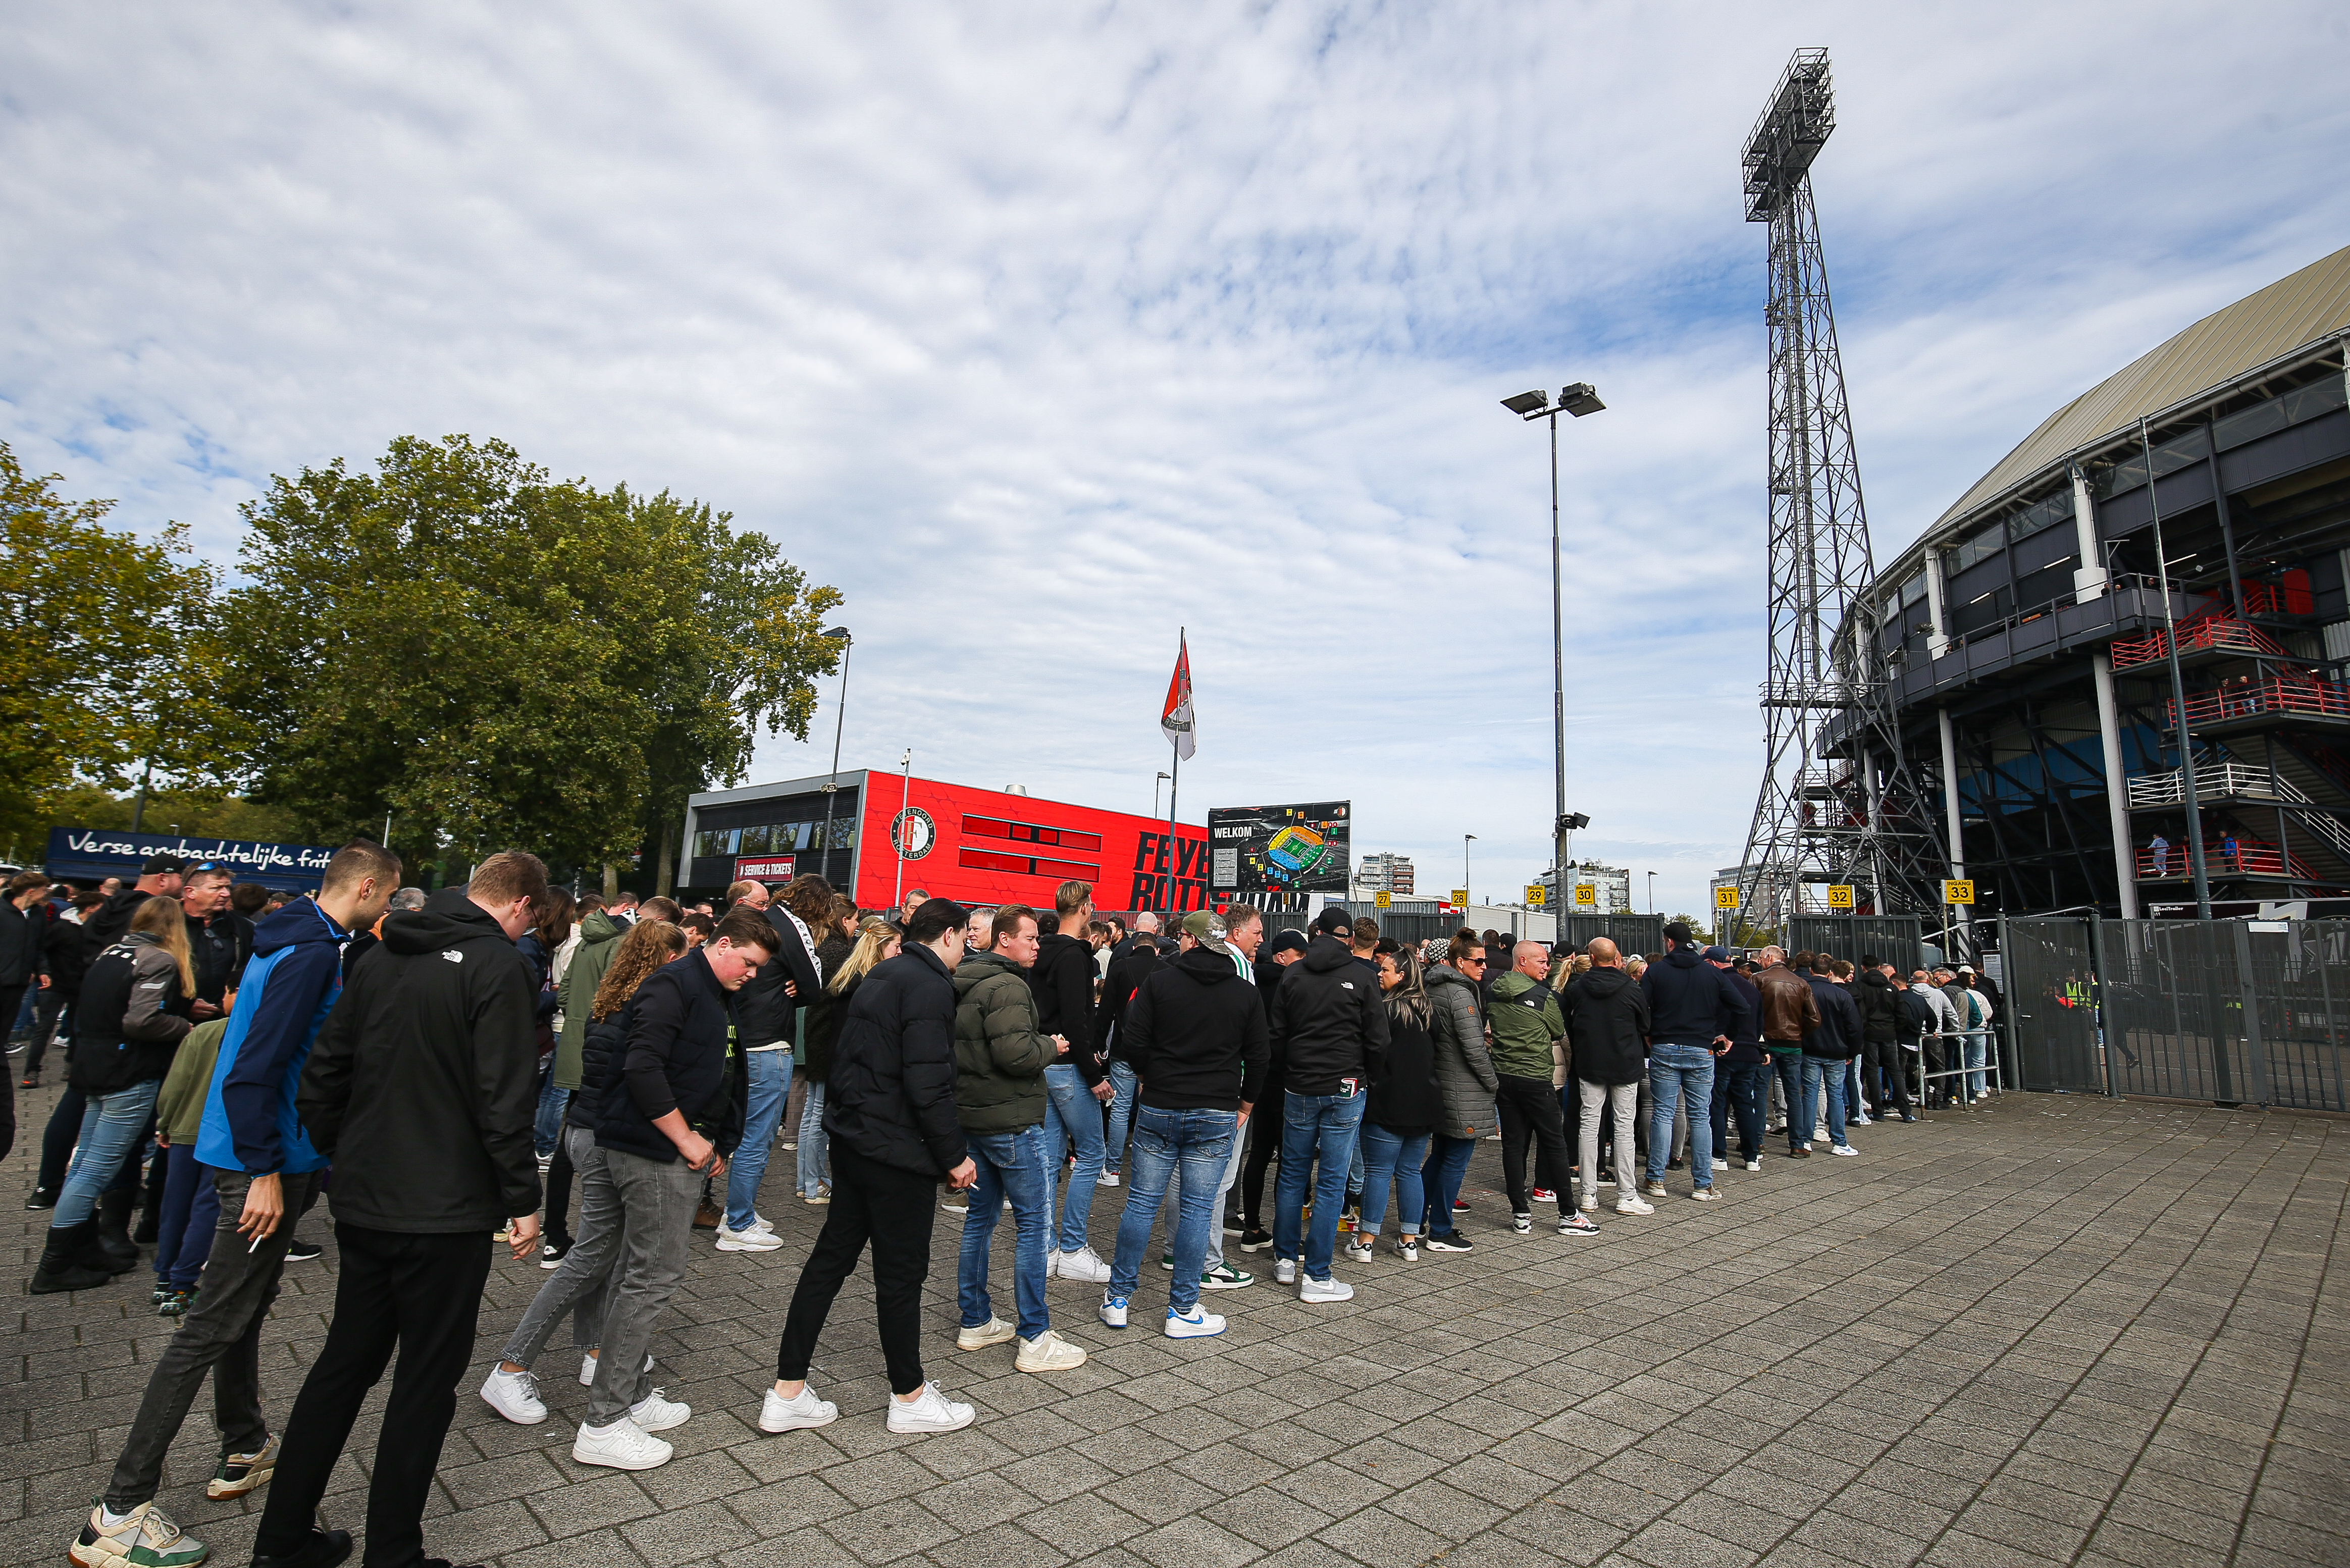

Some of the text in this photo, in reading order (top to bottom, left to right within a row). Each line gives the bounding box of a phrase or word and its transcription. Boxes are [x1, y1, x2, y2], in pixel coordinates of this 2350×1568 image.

[1214, 826, 1252, 839] WELKOM
[68, 831, 136, 855] Verse
[139, 839, 294, 871] ambachtelijke
[893, 839, 931, 858] ROTERDAM
[744, 863, 792, 876] SERVICE & TICKETS
[1530, 891, 1541, 900] 29
[1578, 890, 1591, 900] 30
[1832, 892, 1848, 902] 32
[1950, 886, 1969, 898] 33
[1378, 896, 1387, 904] 27
[1454, 895, 1464, 903] 28
[1720, 893, 1733, 903] 31
